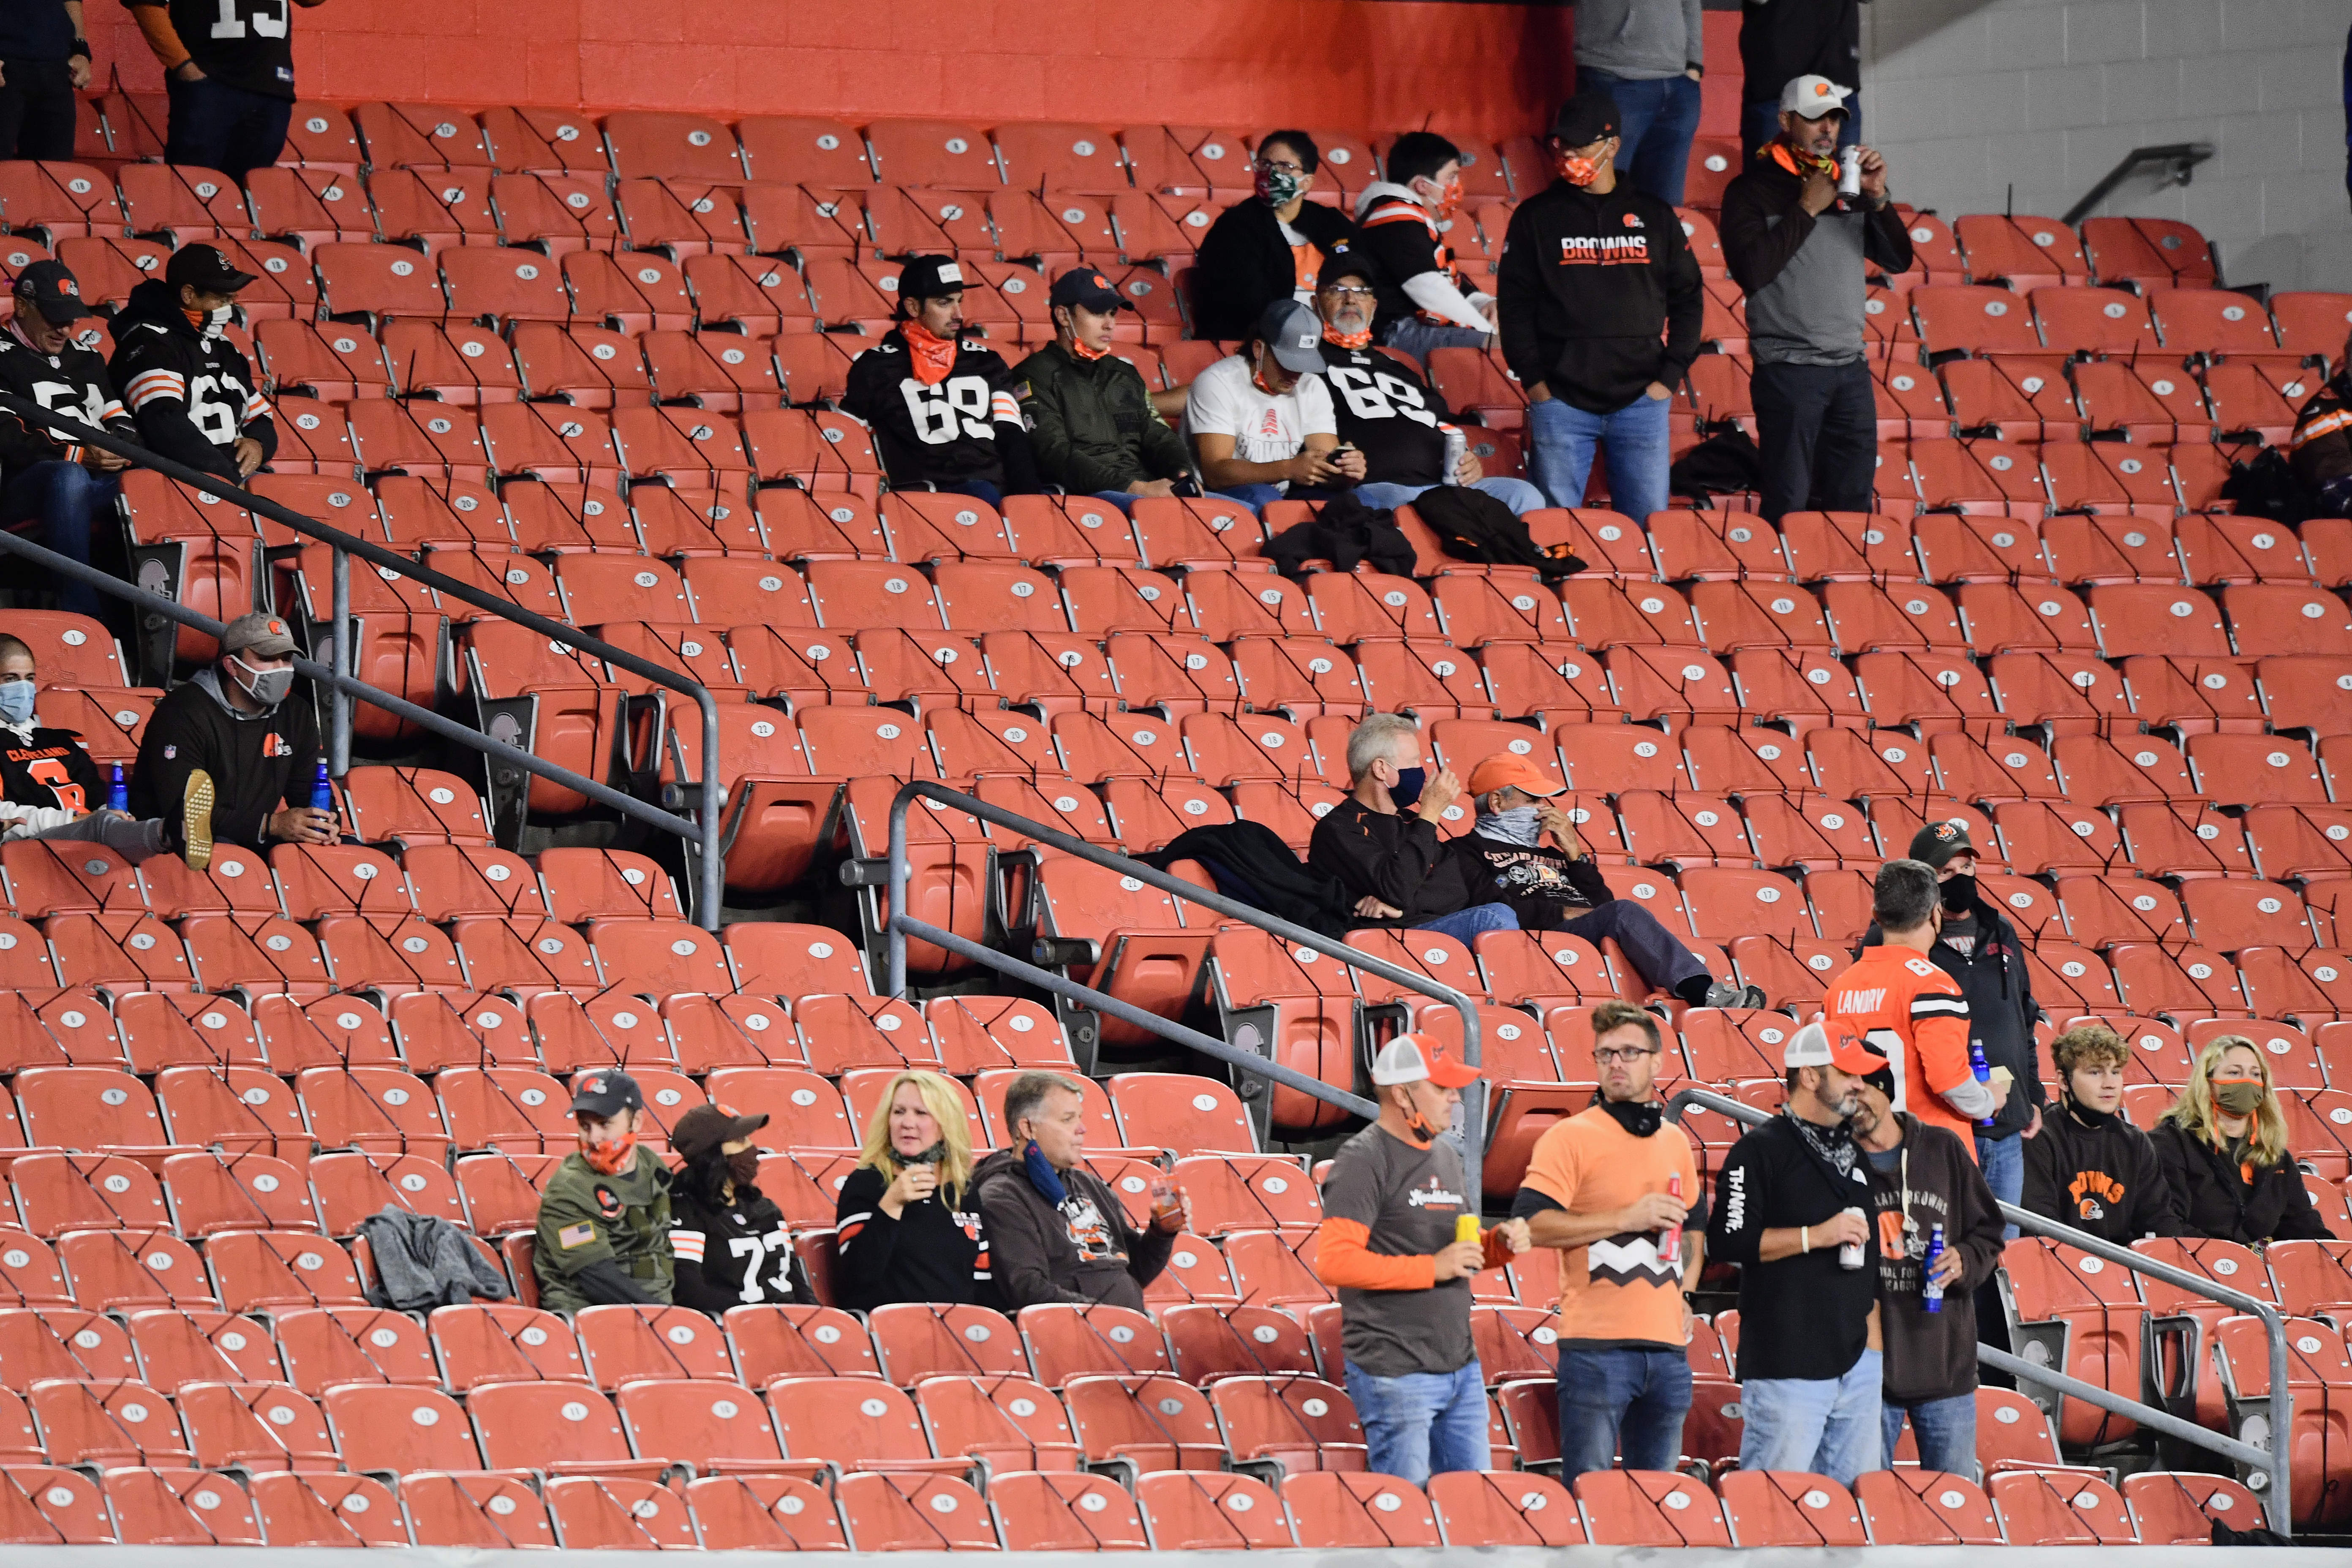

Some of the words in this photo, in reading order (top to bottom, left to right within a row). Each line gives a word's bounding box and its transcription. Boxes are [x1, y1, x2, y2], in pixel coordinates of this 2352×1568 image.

[312, 121, 321, 129] 13
[1561, 235, 1647, 260] BROWNS
[1327, 365, 1436, 428] 69
[899, 376, 995, 444] 69
[303, 418, 313, 426] 20
[334, 495, 344, 504] 21
[838, 511, 846, 519] 17
[758, 725, 768, 733] 22
[6, 747, 71, 762] CLEVELAND
[2141, 755, 2151, 763] 11
[440, 792, 444, 800] 1
[1062, 800, 1070, 808] 21
[1191, 803, 1200, 811] 20
[1448, 808, 1457, 817] 18
[2078, 825, 2087, 833] 13
[363, 867, 368, 875] 3
[495, 869, 501, 877] 2
[630, 872, 634, 880] 1
[1127, 879, 1137, 887] 22
[1763, 891, 1772, 899] 17
[2, 937, 6, 945] 7
[276, 939, 281, 947] 5
[681, 944, 687, 952] 2
[1301, 951, 1311, 959] 22
[1431, 952, 1440, 961] 21
[1562, 953, 1571, 961] 20
[1816, 958, 1826, 966] 18
[2195, 967, 2205, 975] 15
[1837, 988, 1886, 1014] LANDRY
[212, 1017, 216, 1025] 7
[487, 1016, 492, 1024] 5
[887, 1019, 891, 1027] 2
[1504, 1028, 1514, 1036] 22
[1767, 1032, 1776, 1040] 20
[254, 1092, 259, 1100] 8
[394, 1093, 397, 1101] 7
[666, 1093, 671, 1102] 5
[1203, 1099, 1207, 1107] 1
[2337, 1112, 2346, 1120] 17
[1130, 1181, 1136, 1189] 3
[1272, 1181, 1278, 1190] 2
[728, 1230, 792, 1303] 73
[2087, 1261, 2096, 1269] 21
[2221, 1263, 2231, 1271] 20
[2305, 1341, 2314, 1350] 21
[2254, 1476, 2261, 1485] 10
[2219, 1498, 2223, 1506] 1
